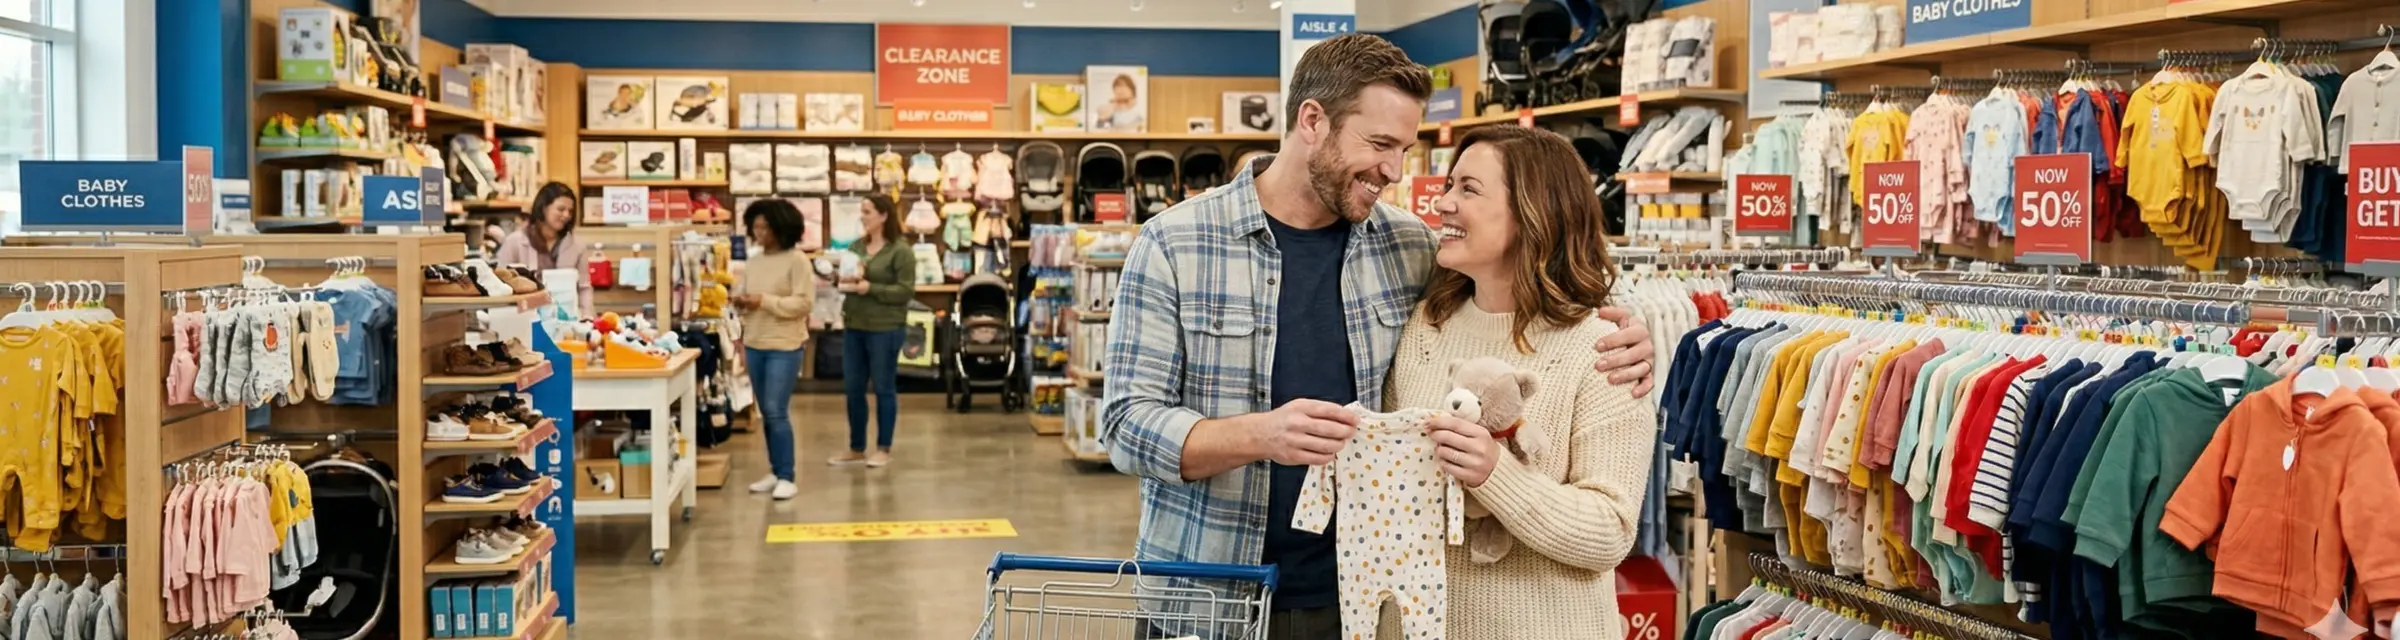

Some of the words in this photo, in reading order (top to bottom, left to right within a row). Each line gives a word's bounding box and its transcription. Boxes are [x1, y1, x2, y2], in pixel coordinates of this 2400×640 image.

[1912, 1, 1949, 23] BABY
[1300, 21, 1336, 33] AISLE
[1339, 22, 1348, 32] 4
[884, 47, 1001, 65] CLEARANCE
[917, 67, 970, 84] ZONE
[1878, 173, 1904, 187] NOW
[2034, 168, 2068, 184] NOW
[2358, 167, 2400, 193] BUY
[78, 179, 128, 192] BABY
[1425, 184, 1446, 193] NO
[1751, 182, 1777, 192] NOW
[61, 194, 145, 208] CLOTHES
[382, 189, 422, 211] AS
[1741, 195, 1787, 217] 50%
[1867, 192, 1913, 225] 50%
[1898, 214, 1914, 225] OFF
[2020, 190, 2081, 227] 50%
[2061, 216, 2082, 227] OFF
[2356, 199, 2400, 227] GET
